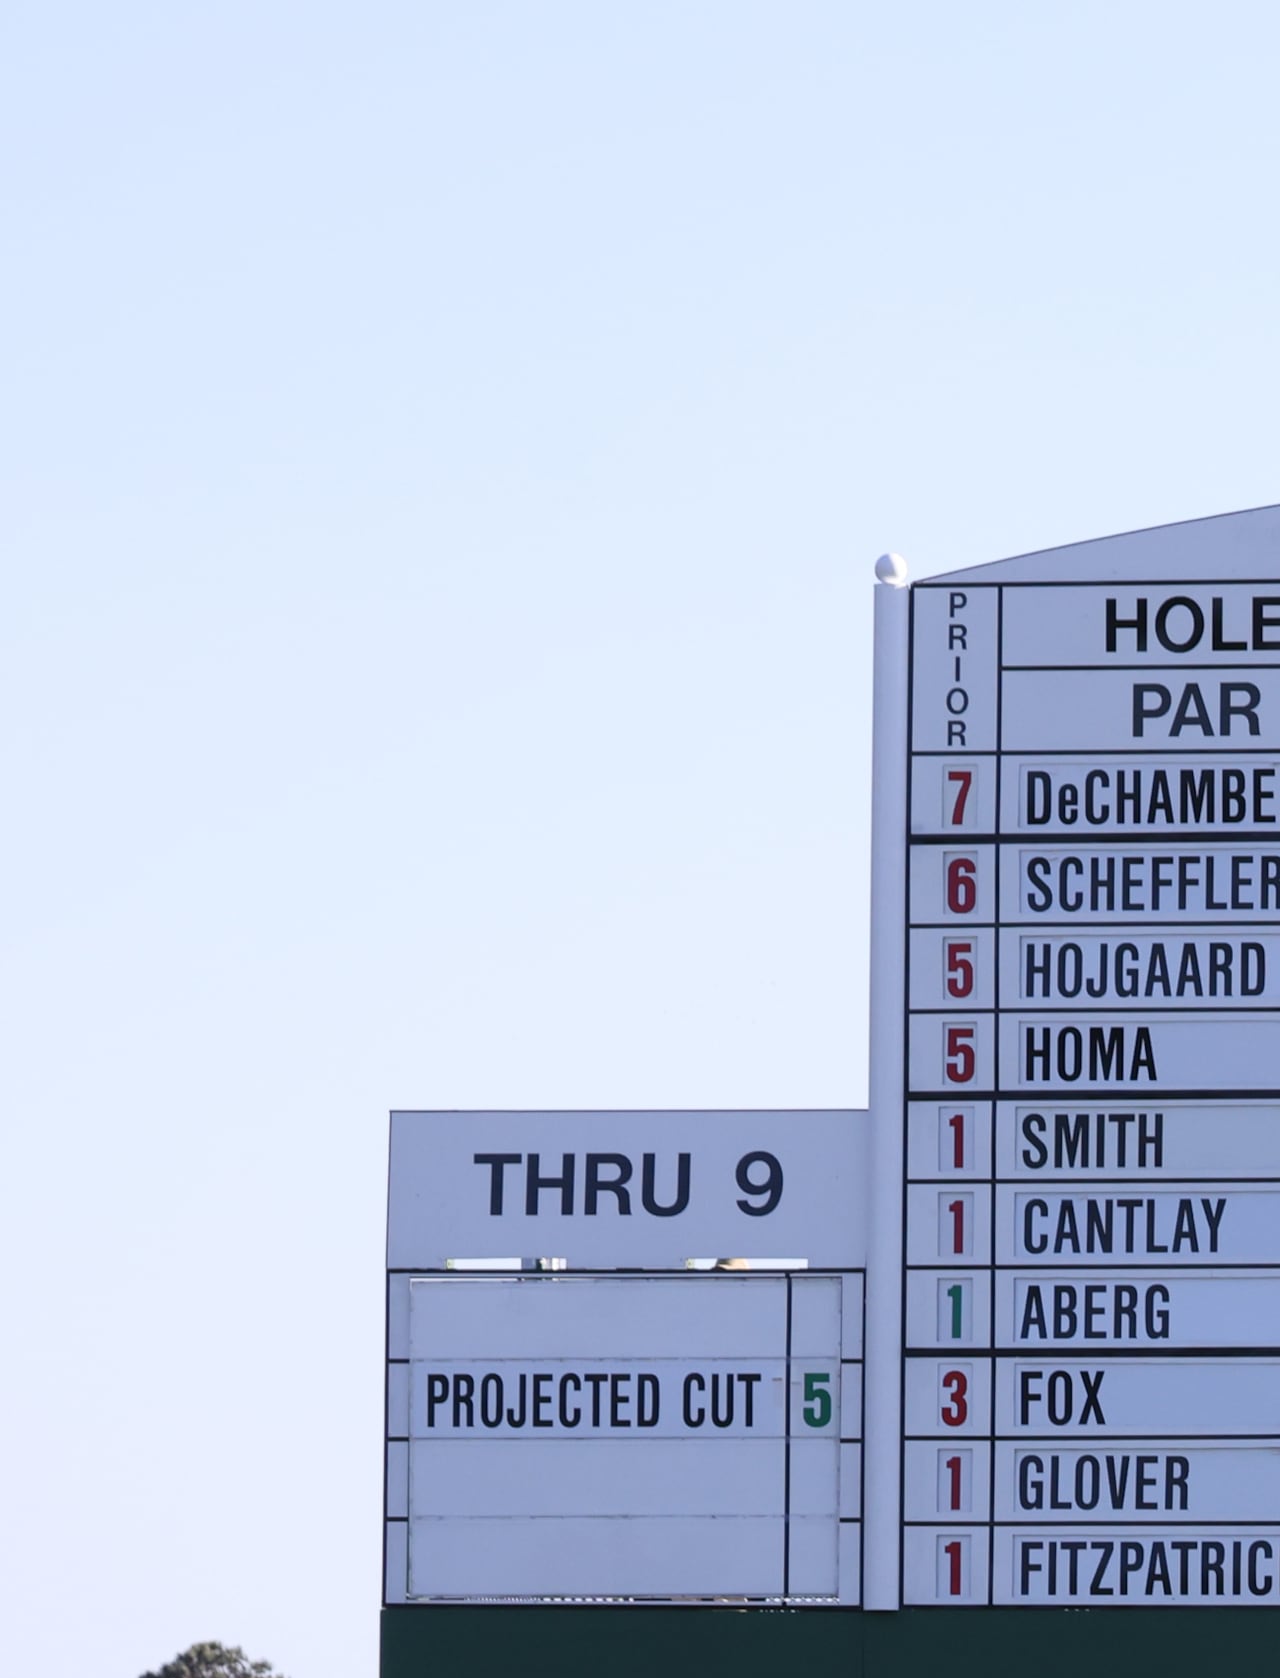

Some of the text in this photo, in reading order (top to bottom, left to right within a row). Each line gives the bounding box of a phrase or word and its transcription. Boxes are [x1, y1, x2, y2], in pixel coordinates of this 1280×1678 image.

[946, 592, 969, 746] PRIOR
[1132, 682, 1261, 738] PAR
[949, 772, 971, 824] 7
[948, 858, 976, 913] 6
[948, 942, 1266, 998] 5 HOJGAARD
[947, 1026, 1157, 1083] 5 HOMA
[950, 1115, 963, 1168] 1
[1022, 1113, 1164, 1170] SMITH
[473, 1151, 784, 1217] THRU 9
[949, 1198, 1227, 1254] 1 CANTLAY
[947, 1285, 962, 1338] 1
[1020, 1284, 1170, 1339] ABERG
[427, 1372, 832, 1429] PROJECTED CUT 5
[942, 1370, 1106, 1426] 3 FOX
[947, 1454, 1190, 1511] 1 GLOVER
[945, 1542, 961, 1595] 1
